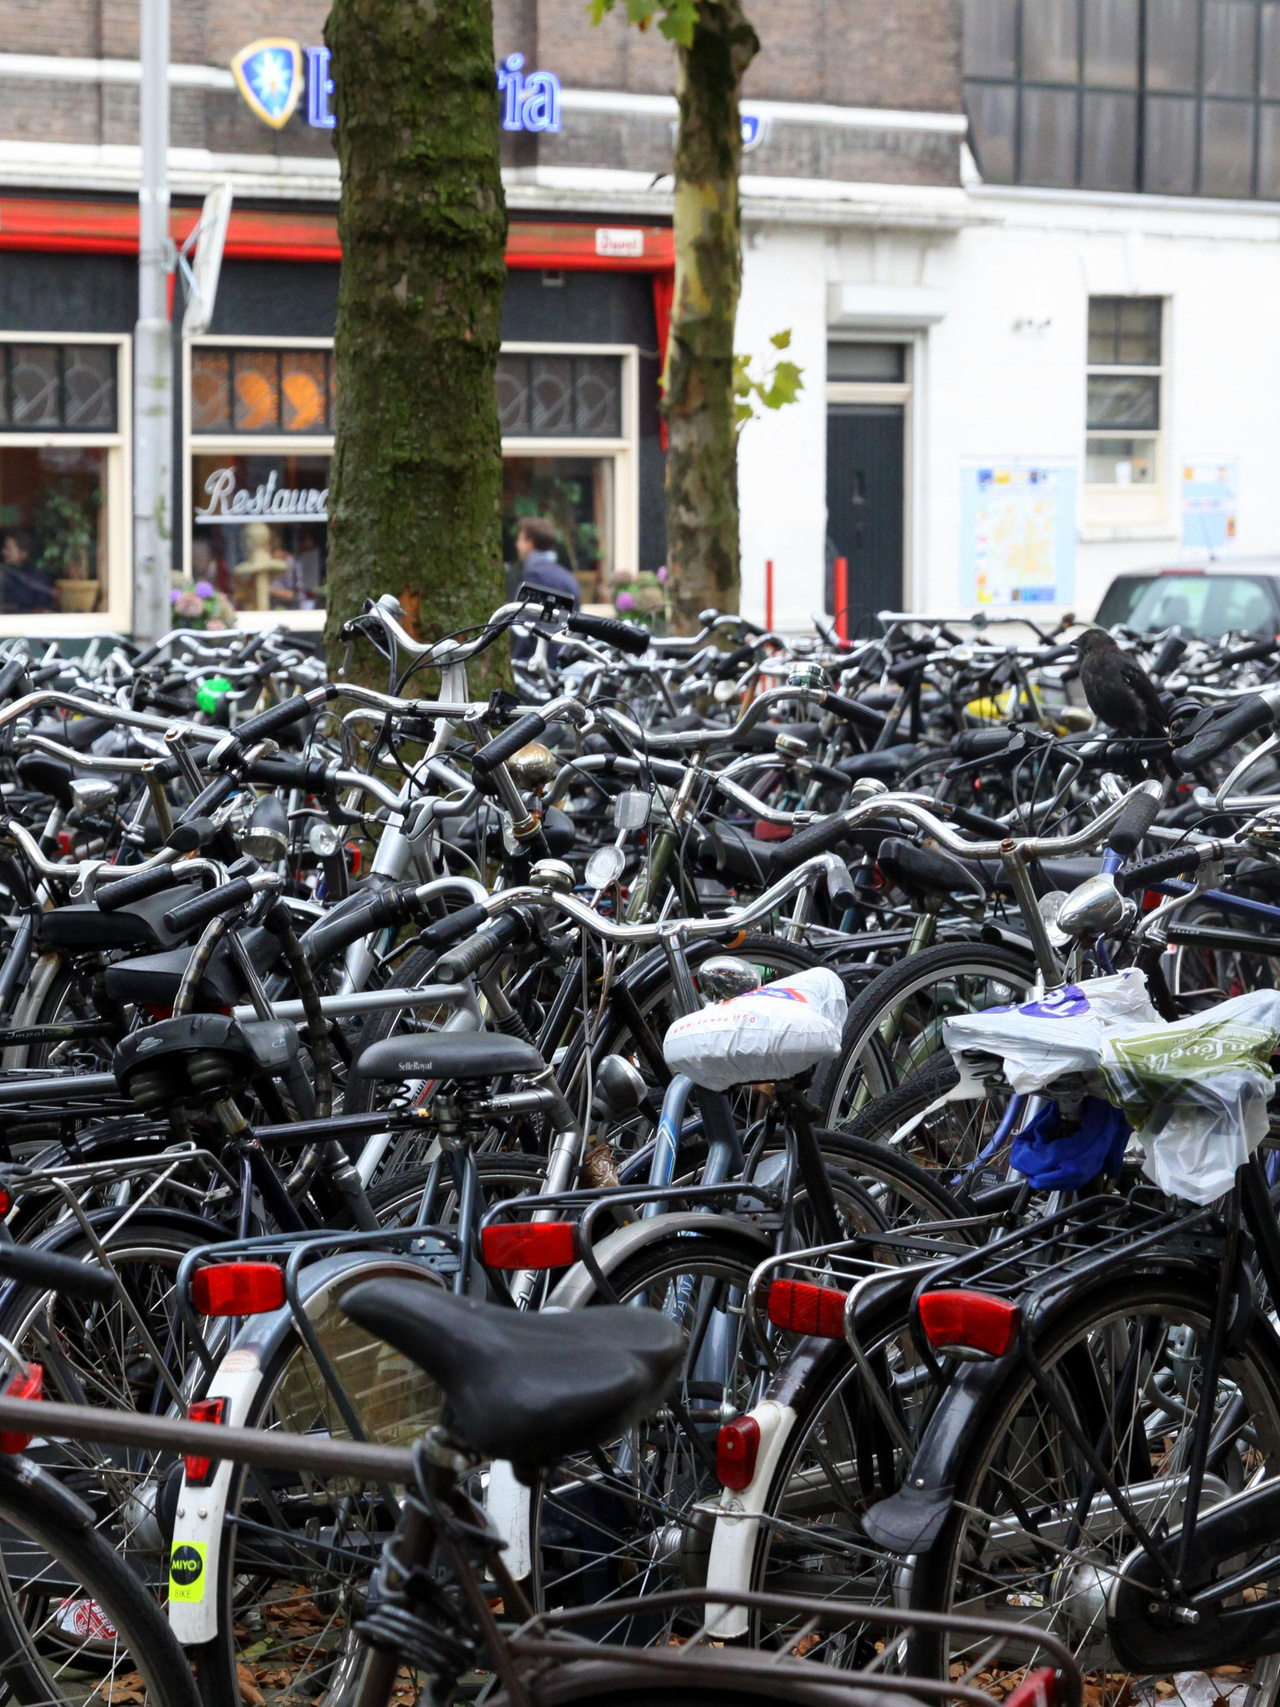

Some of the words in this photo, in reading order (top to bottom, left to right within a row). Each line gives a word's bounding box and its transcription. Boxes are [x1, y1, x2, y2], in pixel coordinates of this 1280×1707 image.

[194, 466, 329, 516] Restaura
[174, 1590, 191, 1598] BIKE
[91, 1605, 115, 1633] BEER
